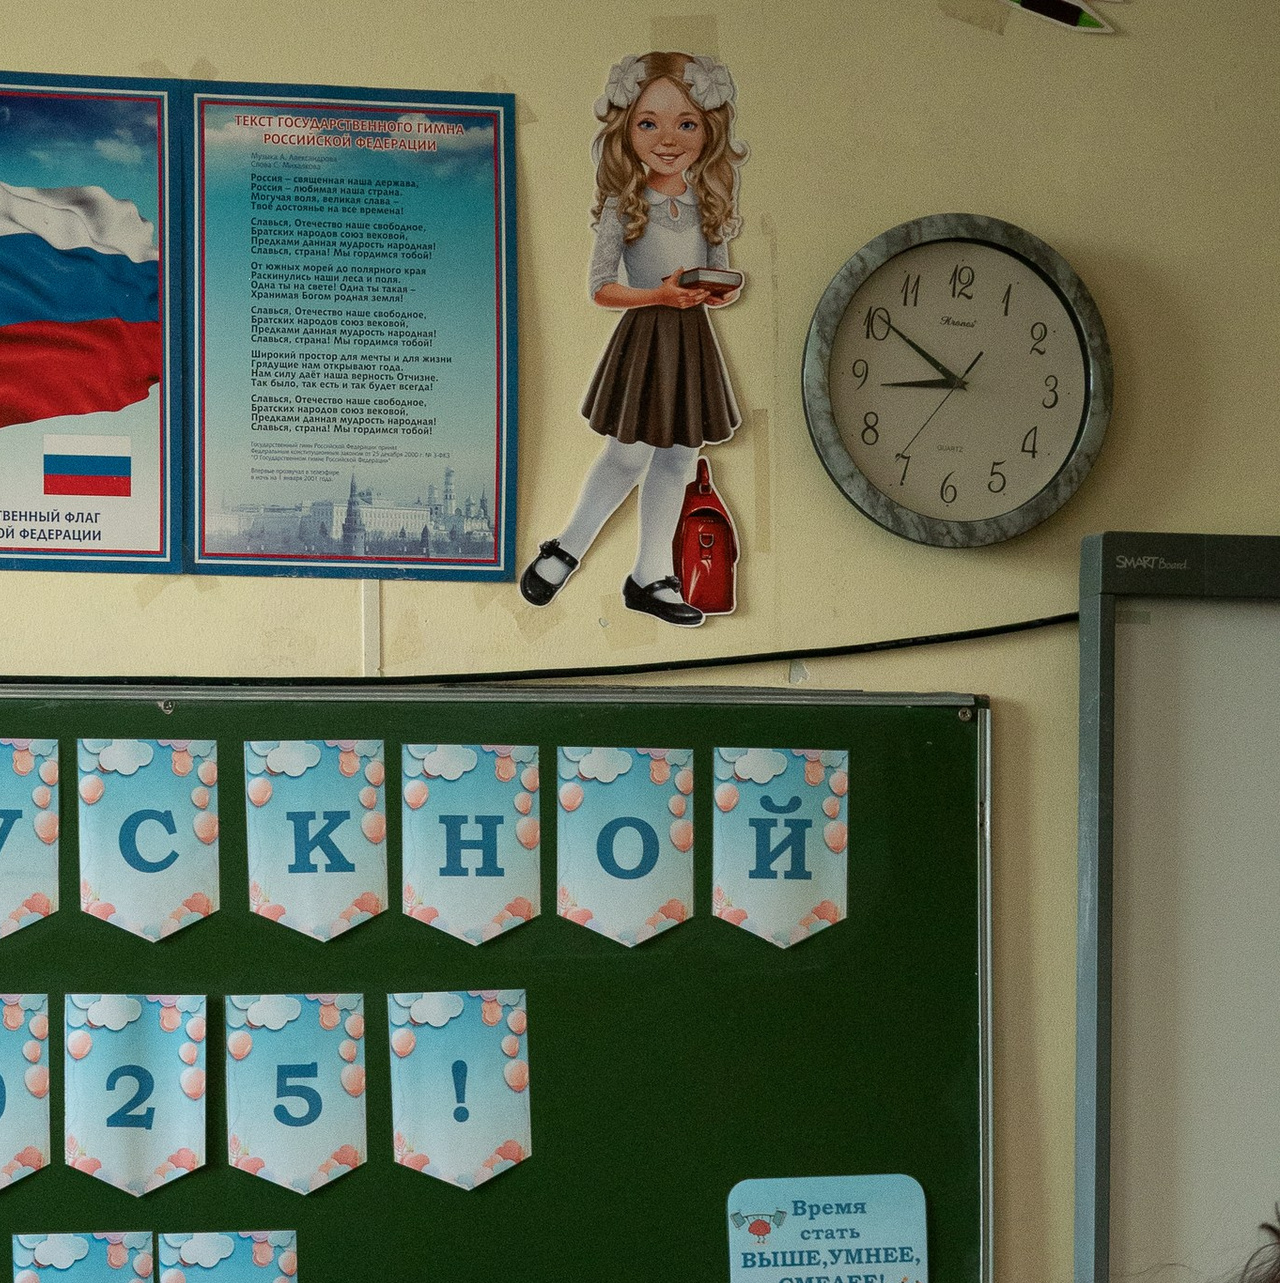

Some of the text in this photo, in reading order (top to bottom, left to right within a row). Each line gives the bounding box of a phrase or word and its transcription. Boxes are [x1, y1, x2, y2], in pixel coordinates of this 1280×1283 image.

[235, 115, 464, 135] ТЕКСТ ГОСУДАРСТВЕННОГО ГИМНА
[263, 133, 437, 152] РОССИЙСКОЙ ФЕДЕРАЦИИ
[251, 173, 283, 182] Россия
[293, 176, 345, 186] священная
[348, 178, 372, 186] наша
[251, 182, 283, 192] Россия
[294, 183, 338, 194] любимая
[340, 187, 365, 195] наша
[251, 191, 292, 203] Могучая
[322, 196, 362, 204] великая
[364, 197, 391, 205] слава
[276, 204, 325, 214] достоянье
[360, 205, 404, 217] времена!
[251, 260, 427, 277] От южных морей до полярного края
[251, 270, 311, 283] Раскинулись
[314, 274, 340, 282] наши
[366, 275, 373, 283] и
[950, 264, 976, 300] 12
[251, 279, 276, 290] Одна
[308, 281, 337, 291] свете!
[340, 282, 364, 293] Одна
[382, 285, 408, 293] такая
[901, 274, 920, 307] 11
[251, 289, 404, 303] Хранимая Богом родная земля!
[1001, 283, 1012, 317] 1
[295, 306, 343, 316] Отечество
[346, 309, 371, 317] наше
[251, 314, 294, 326] Братских
[297, 317, 338, 328] народов
[863, 306, 891, 342] 10
[251, 324, 437, 340] Предками данная мудрость народная!
[1030, 322, 1048, 355] 2
[295, 335, 330, 346] страна!
[334, 336, 351, 345] Мы
[353, 338, 399, 348] гордимся
[402, 338, 433, 347] тобой!
[251, 349, 296, 361] Широкий
[299, 352, 338, 362] простор
[340, 353, 358, 362] для
[360, 354, 391, 362] мечты
[402, 355, 420, 364] для
[251, 358, 299, 371] Грядущие
[323, 362, 376, 373] открывают
[251, 368, 272, 377] Нам
[274, 370, 296, 380] силу
[299, 369, 320, 380] даёт
[352, 373, 394, 383] верность
[852, 359, 869, 390] 9
[252, 377, 268, 387] Так
[320, 381, 339, 389] есть
[369, 381, 396, 392] будет
[399, 381, 433, 393] всегда!
[1042, 375, 1059, 410] 3
[295, 394, 343, 404] Отечество
[346, 397, 371, 405] наше
[251, 403, 295, 415] Братских
[297, 406, 338, 416] народов
[251, 412, 437, 427] Предками данная мудрость народная!
[295, 423, 331, 434] страна!
[334, 424, 351, 433] Мы
[353, 426, 399, 436] гордимся
[402, 425, 433, 435] тобой!
[861, 411, 879, 446] 8
[937, 445, 963, 453] QUARTZ
[1022, 426, 1038, 459] 4
[895, 452, 911, 486] 7
[987, 460, 1007, 493] 5
[940, 471, 958, 504] 6
[64, 511, 101, 523] ФЛАГ
[20, 528, 101, 542] ФЕДЕРАЦИИ
[1116, 555, 1159, 569] SMART
[792, 1200, 866, 1220] Время
[801, 1227, 860, 1240] стать
